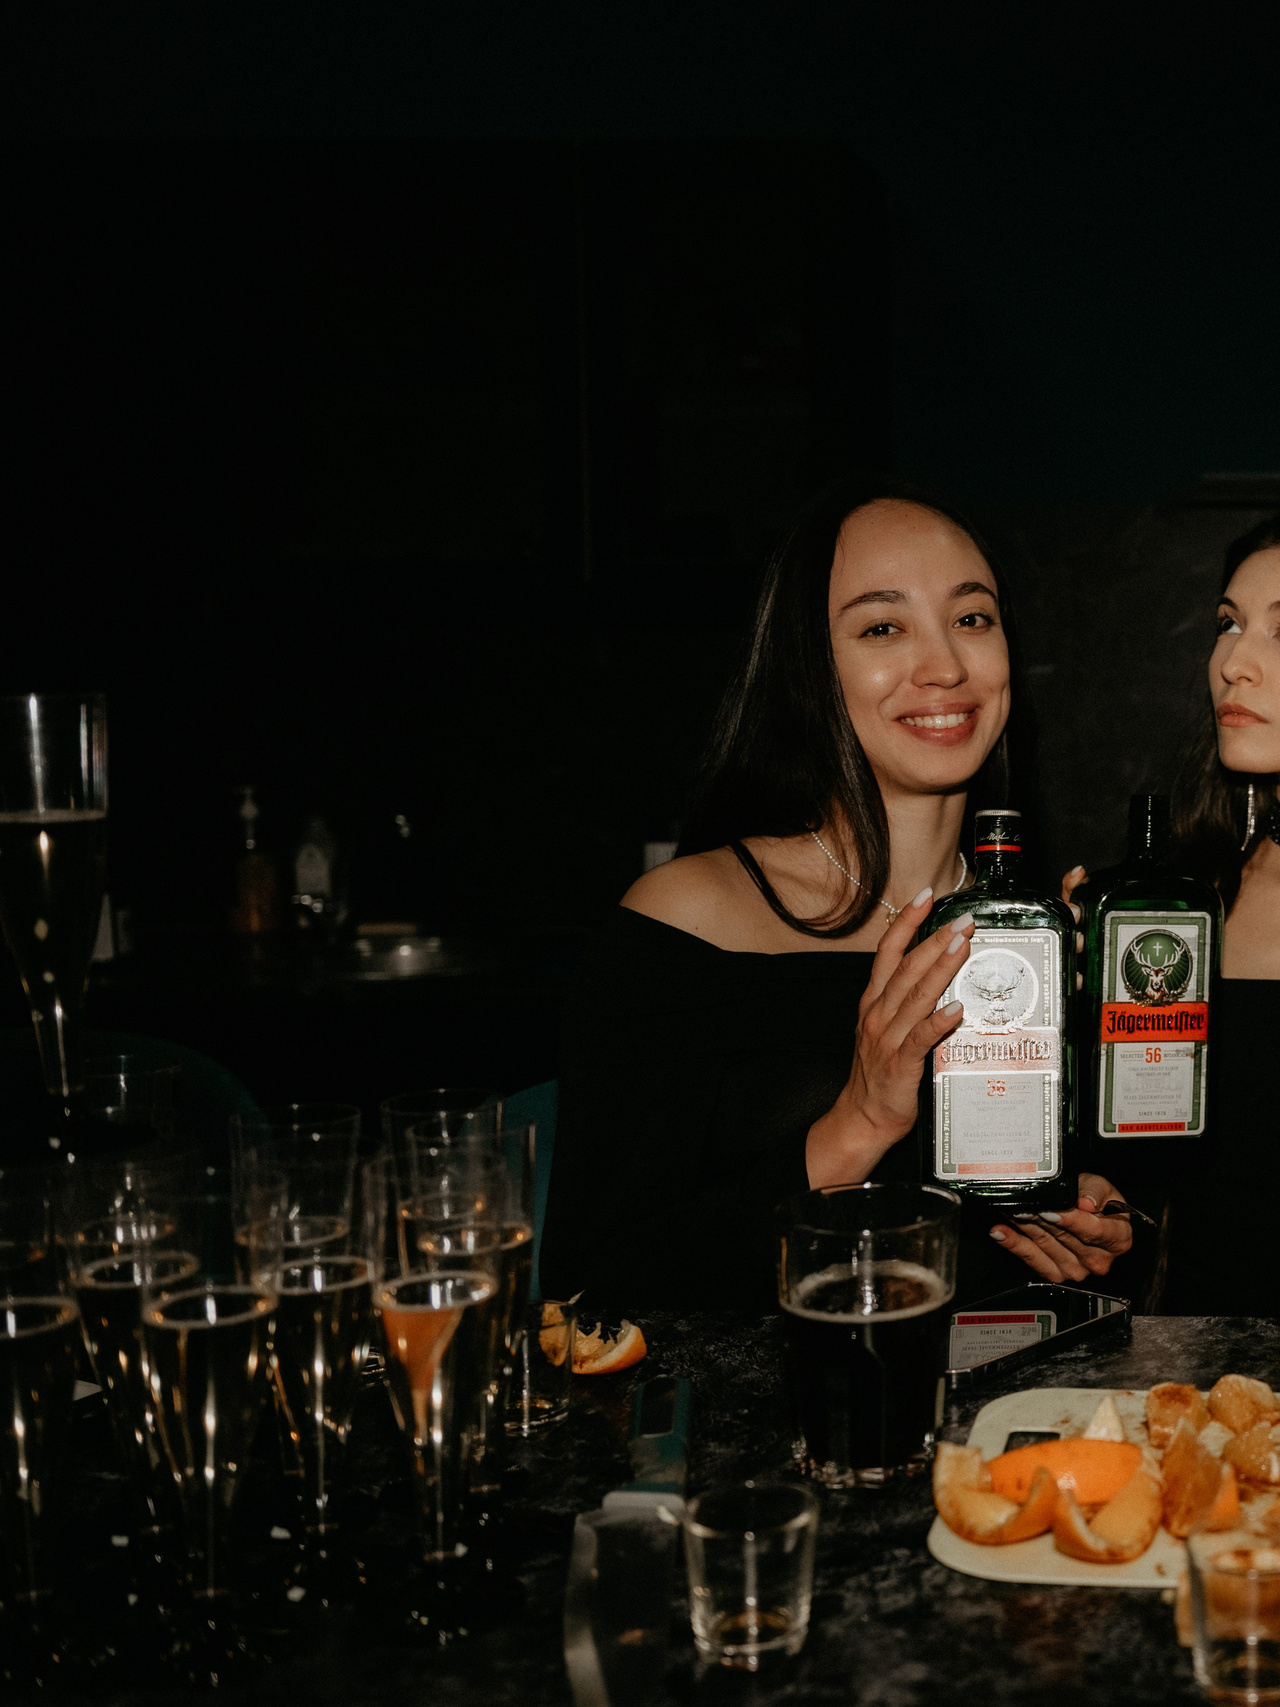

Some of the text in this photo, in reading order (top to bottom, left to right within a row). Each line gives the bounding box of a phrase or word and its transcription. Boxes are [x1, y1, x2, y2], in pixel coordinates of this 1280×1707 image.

[1106, 1010, 1204, 1035] Jägermeister
[941, 1038, 1052, 1064] Jägermeister
[1145, 1047, 1162, 1063] 56
[986, 1079, 1006, 1097] 56
